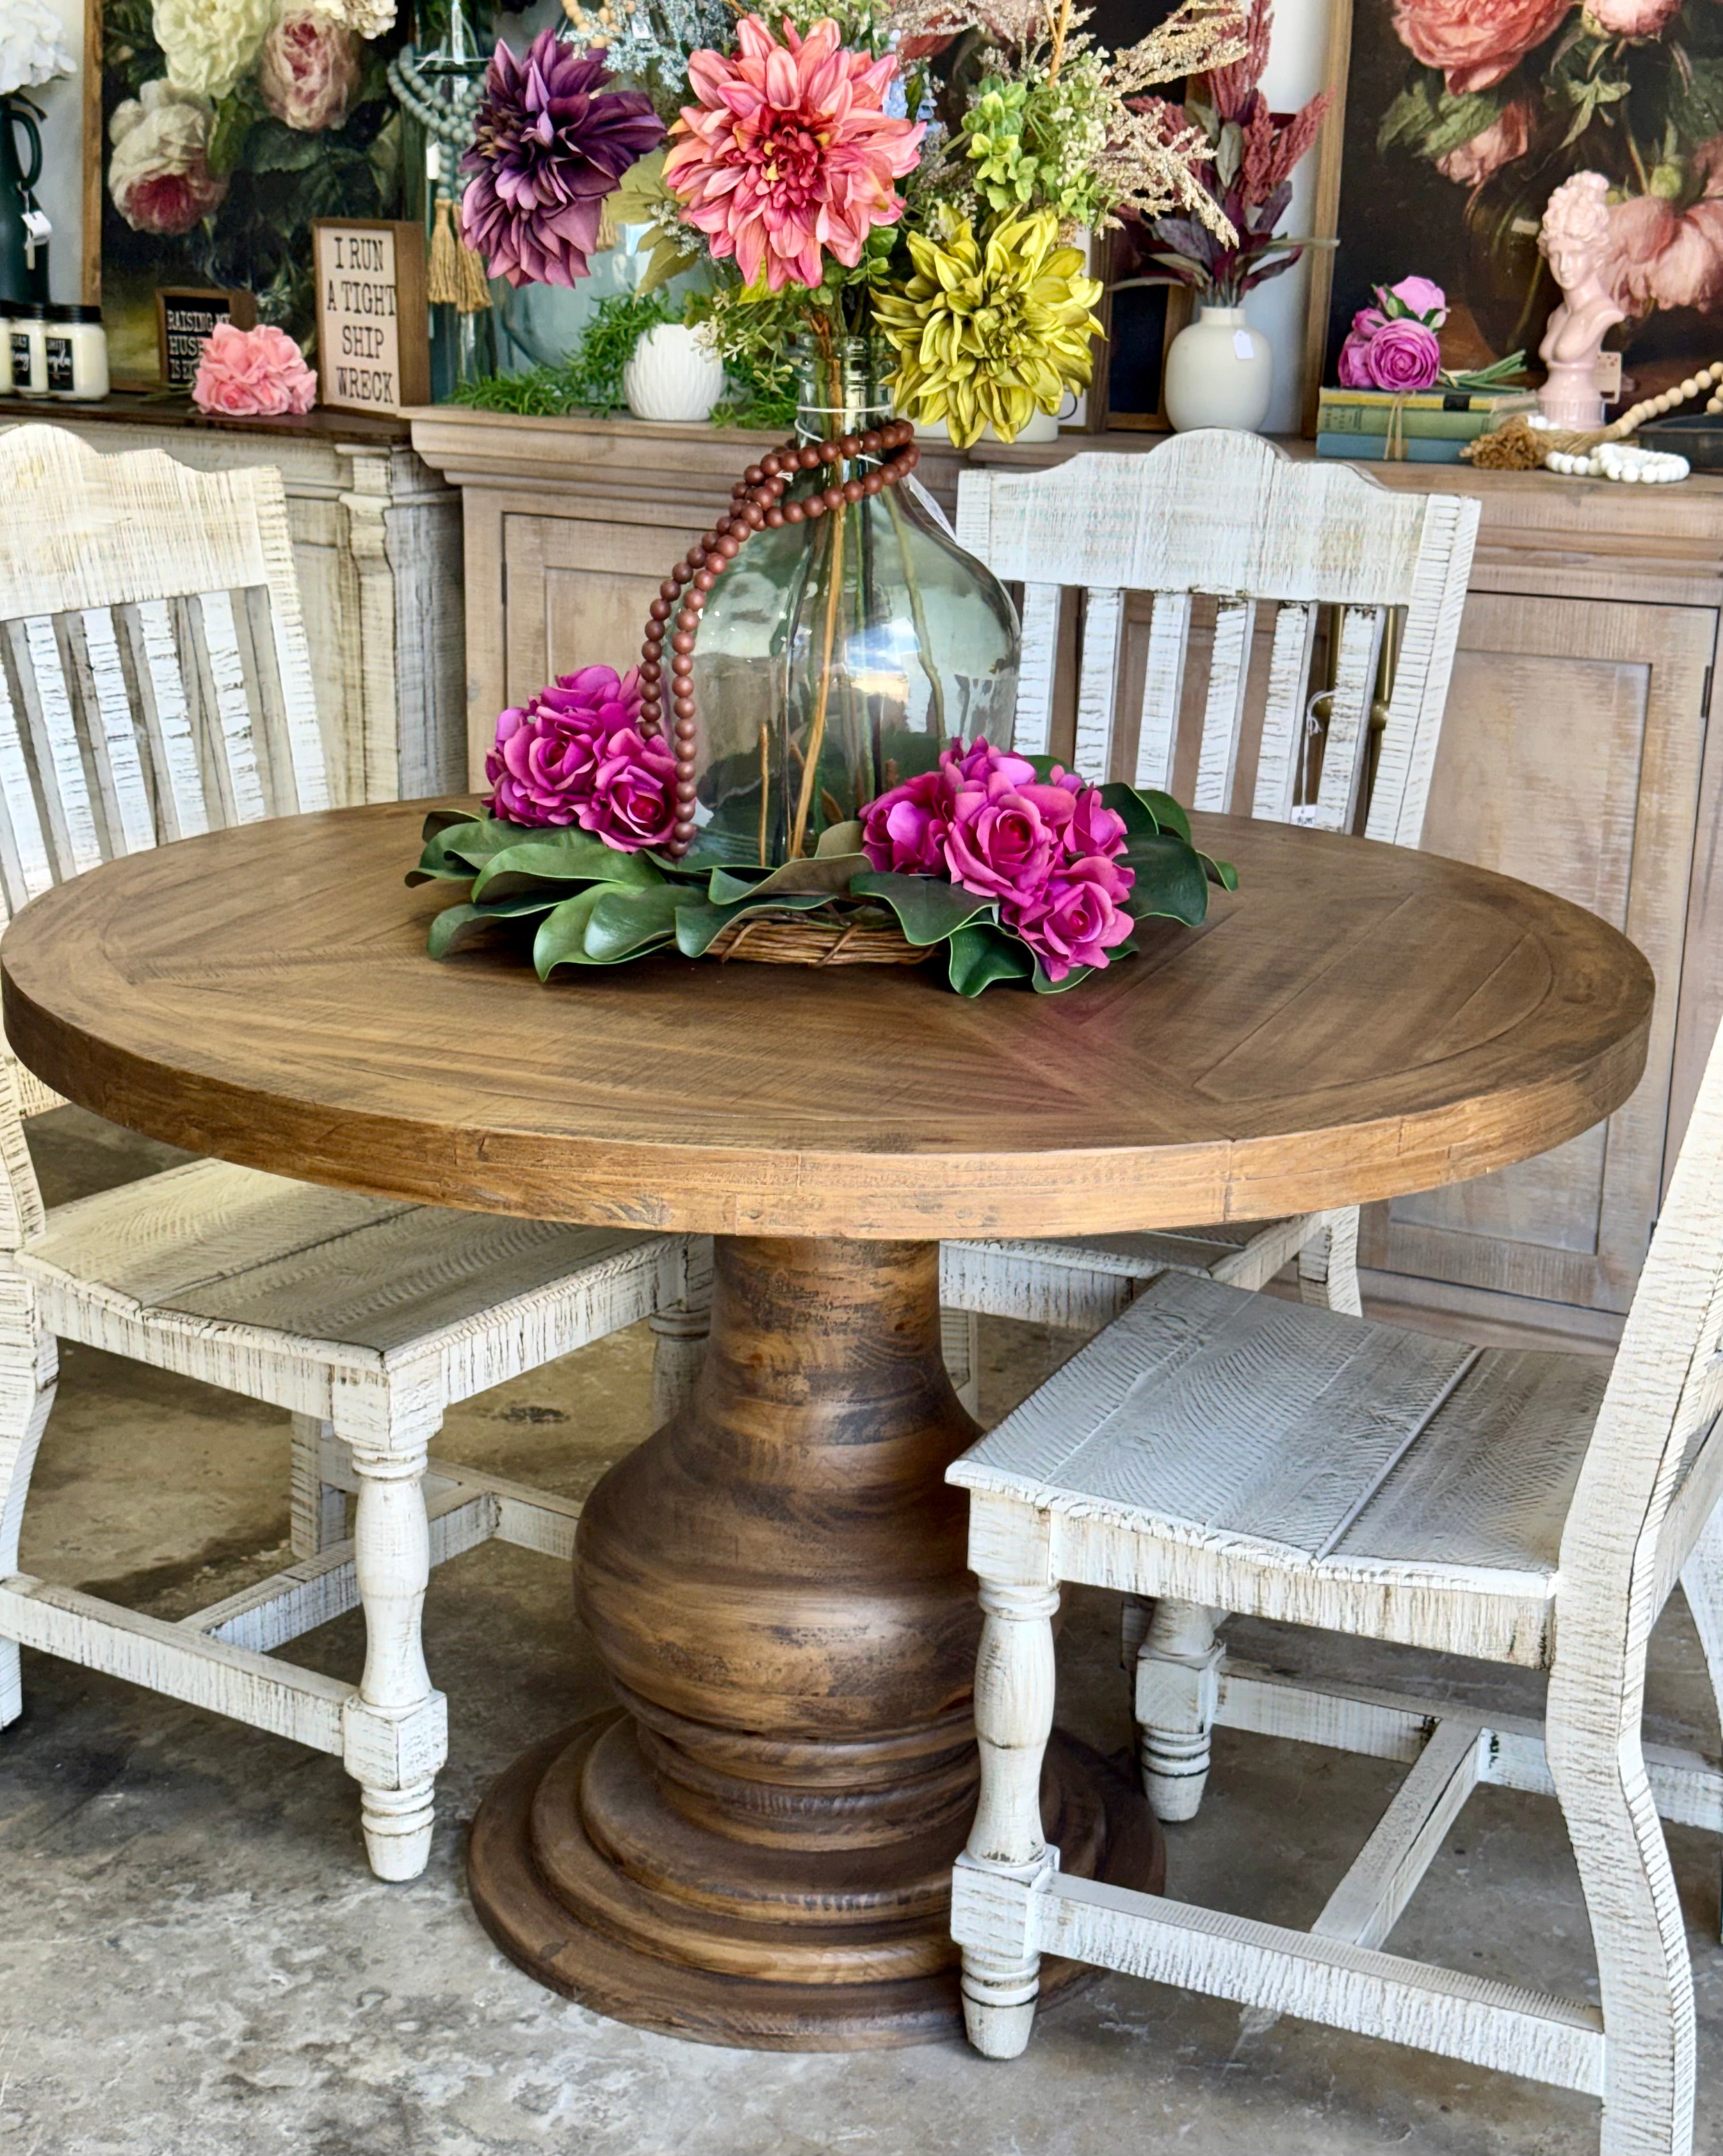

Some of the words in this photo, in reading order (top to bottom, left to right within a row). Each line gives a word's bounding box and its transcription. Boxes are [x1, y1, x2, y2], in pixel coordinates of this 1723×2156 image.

[334, 237, 343, 269] I
[349, 237, 383, 272] RUN
[327, 280, 337, 311] A
[342, 281, 396, 316] TIGHT
[167, 310, 213, 332] RAISING
[342, 325, 383, 359] SHIP
[337, 366, 393, 403] WRECK
